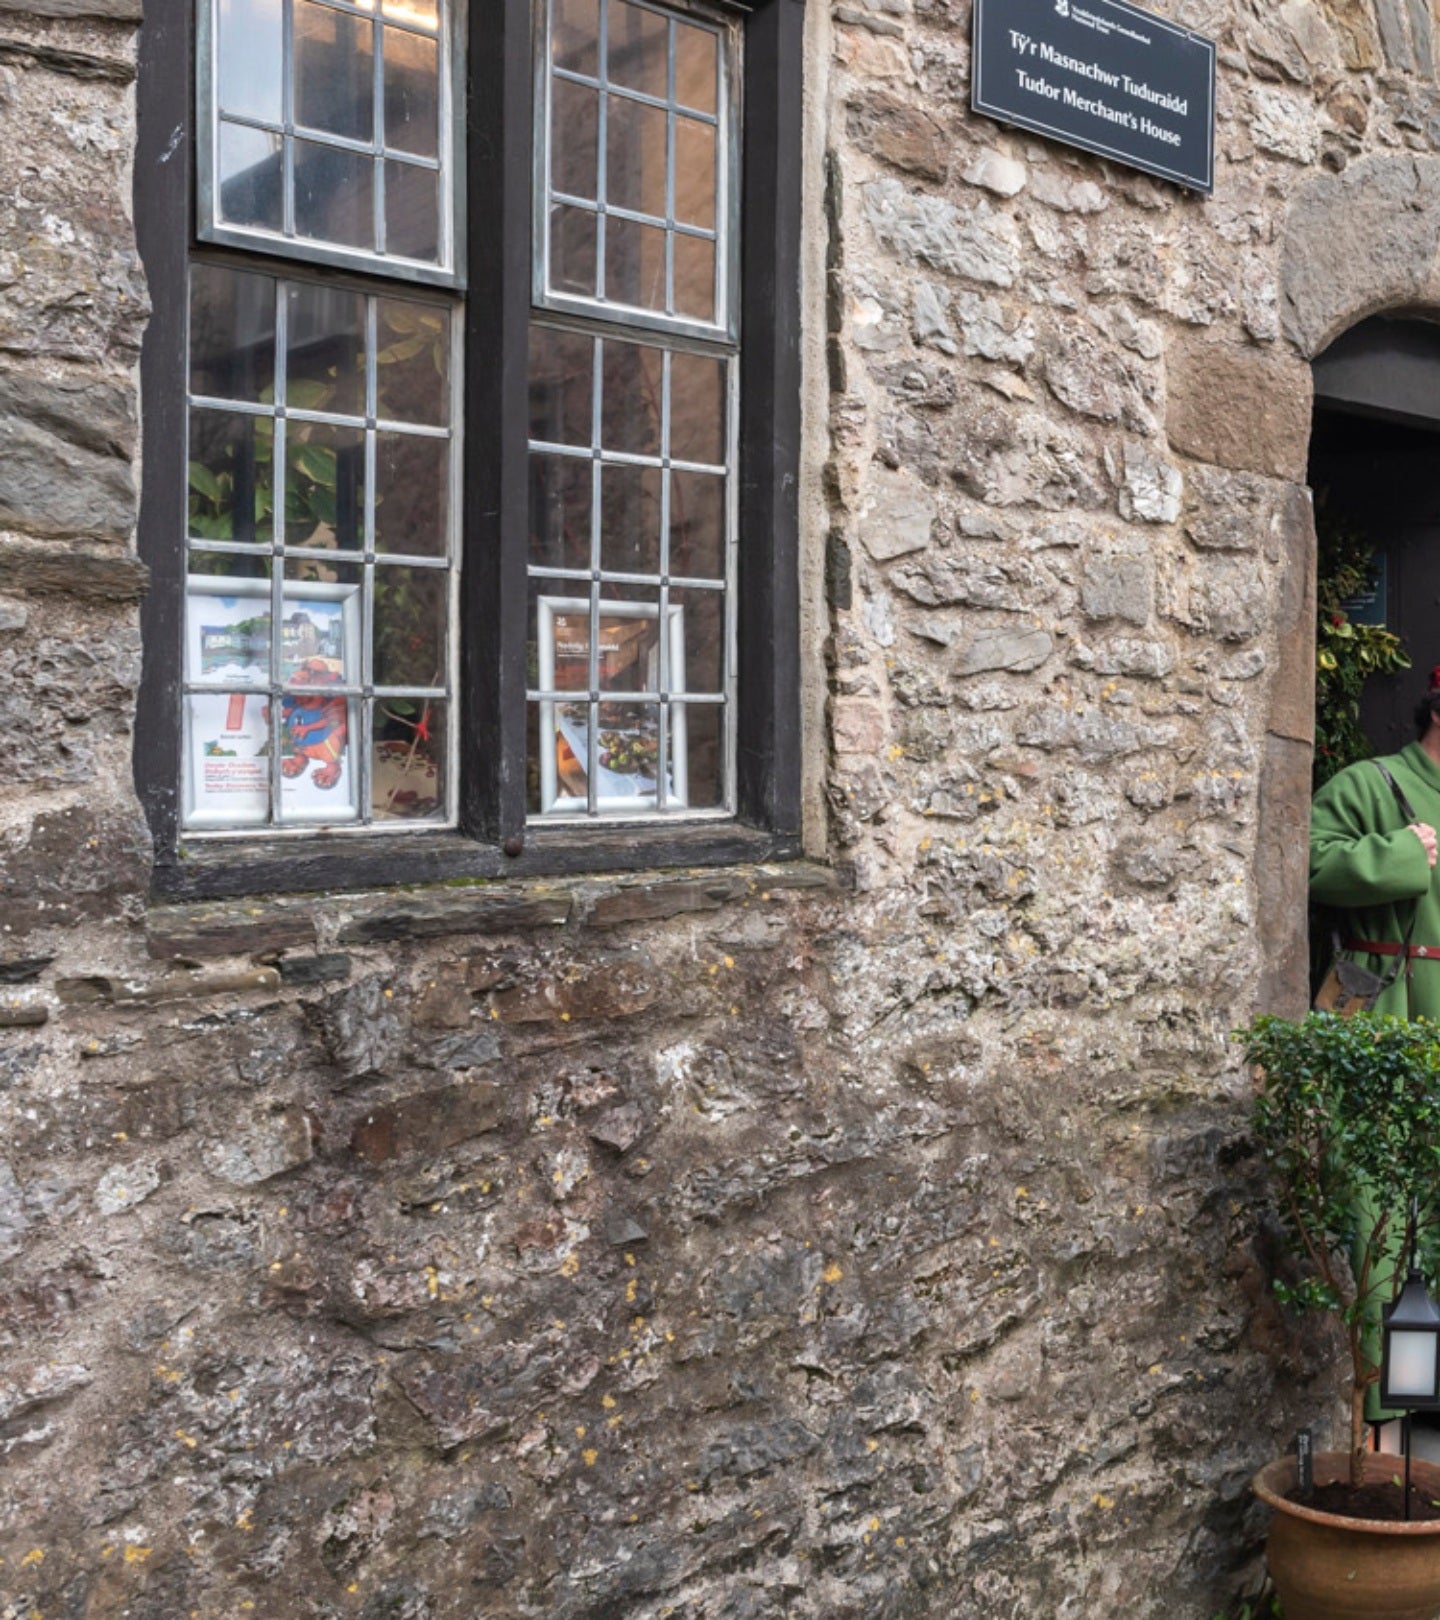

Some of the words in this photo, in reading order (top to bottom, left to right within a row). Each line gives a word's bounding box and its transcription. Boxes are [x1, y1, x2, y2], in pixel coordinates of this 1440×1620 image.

[1015, 69, 1060, 100] Tudor
[1063, 88, 1137, 130] Merchant's
[1140, 117, 1181, 147] House
[1040, 42, 1120, 89] Masnachwr
[1121, 75, 1188, 116] Tuduraidd
